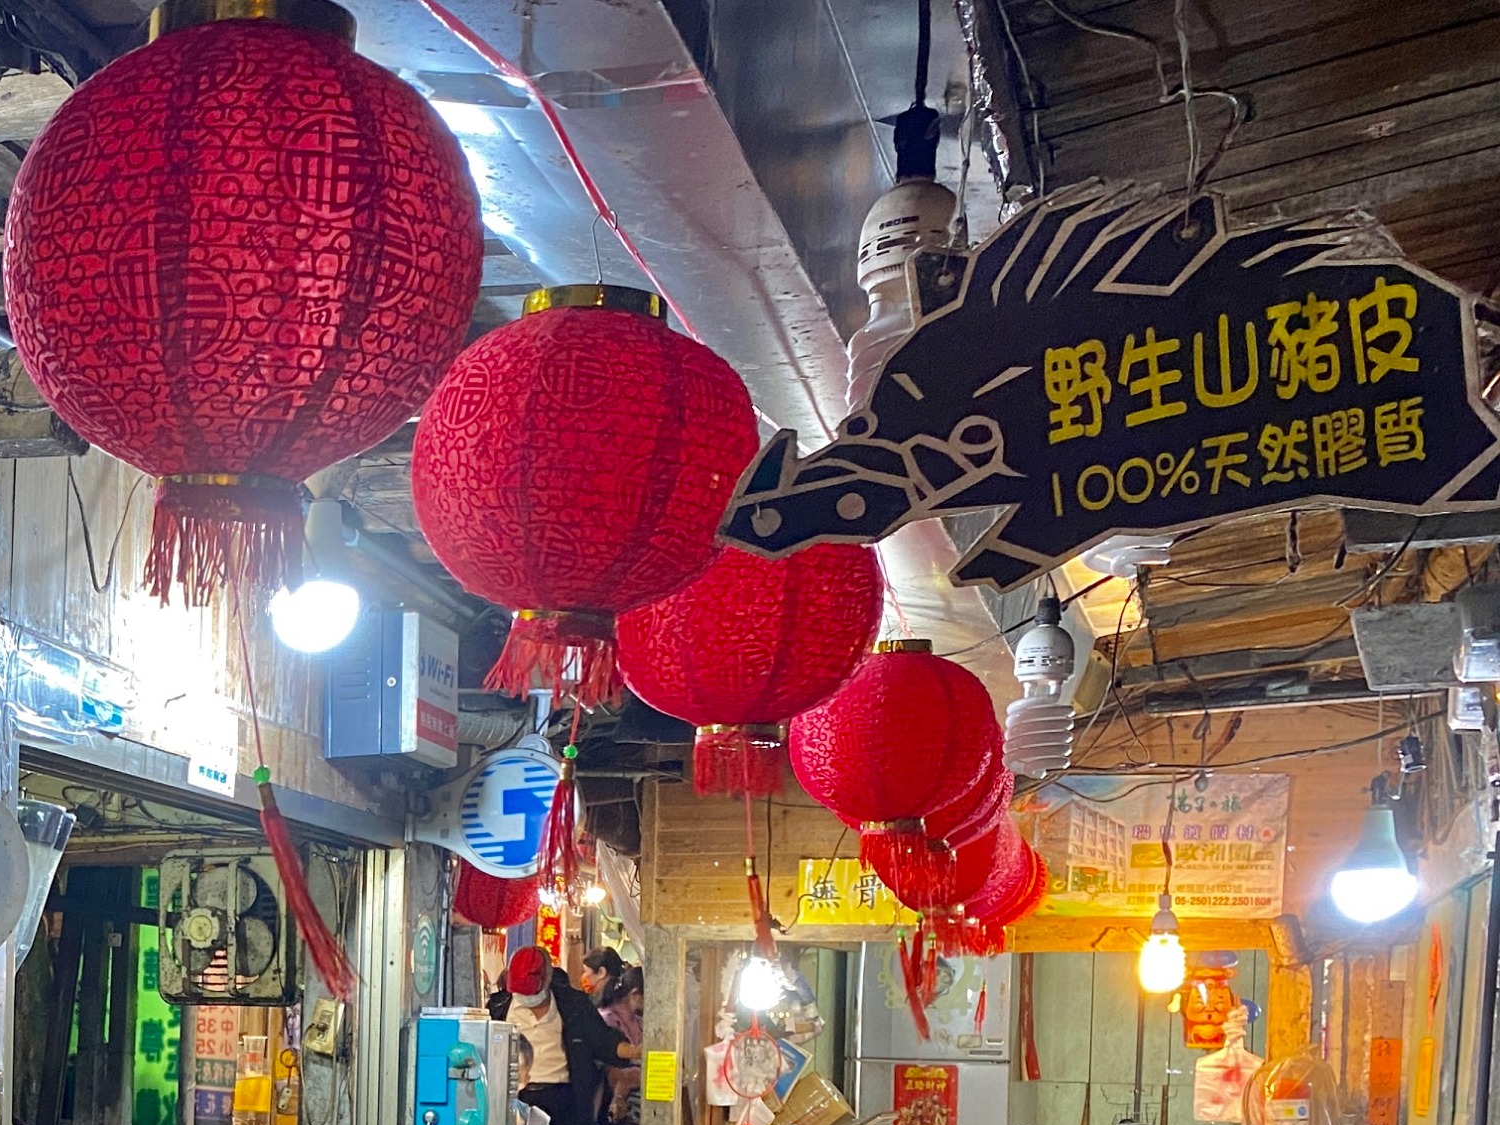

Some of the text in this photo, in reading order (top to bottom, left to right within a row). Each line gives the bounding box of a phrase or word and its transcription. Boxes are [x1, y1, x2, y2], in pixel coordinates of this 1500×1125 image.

[1043, 276, 1421, 446] 野生山豬皮
[1050, 396, 1427, 518] 100%天然膠質
